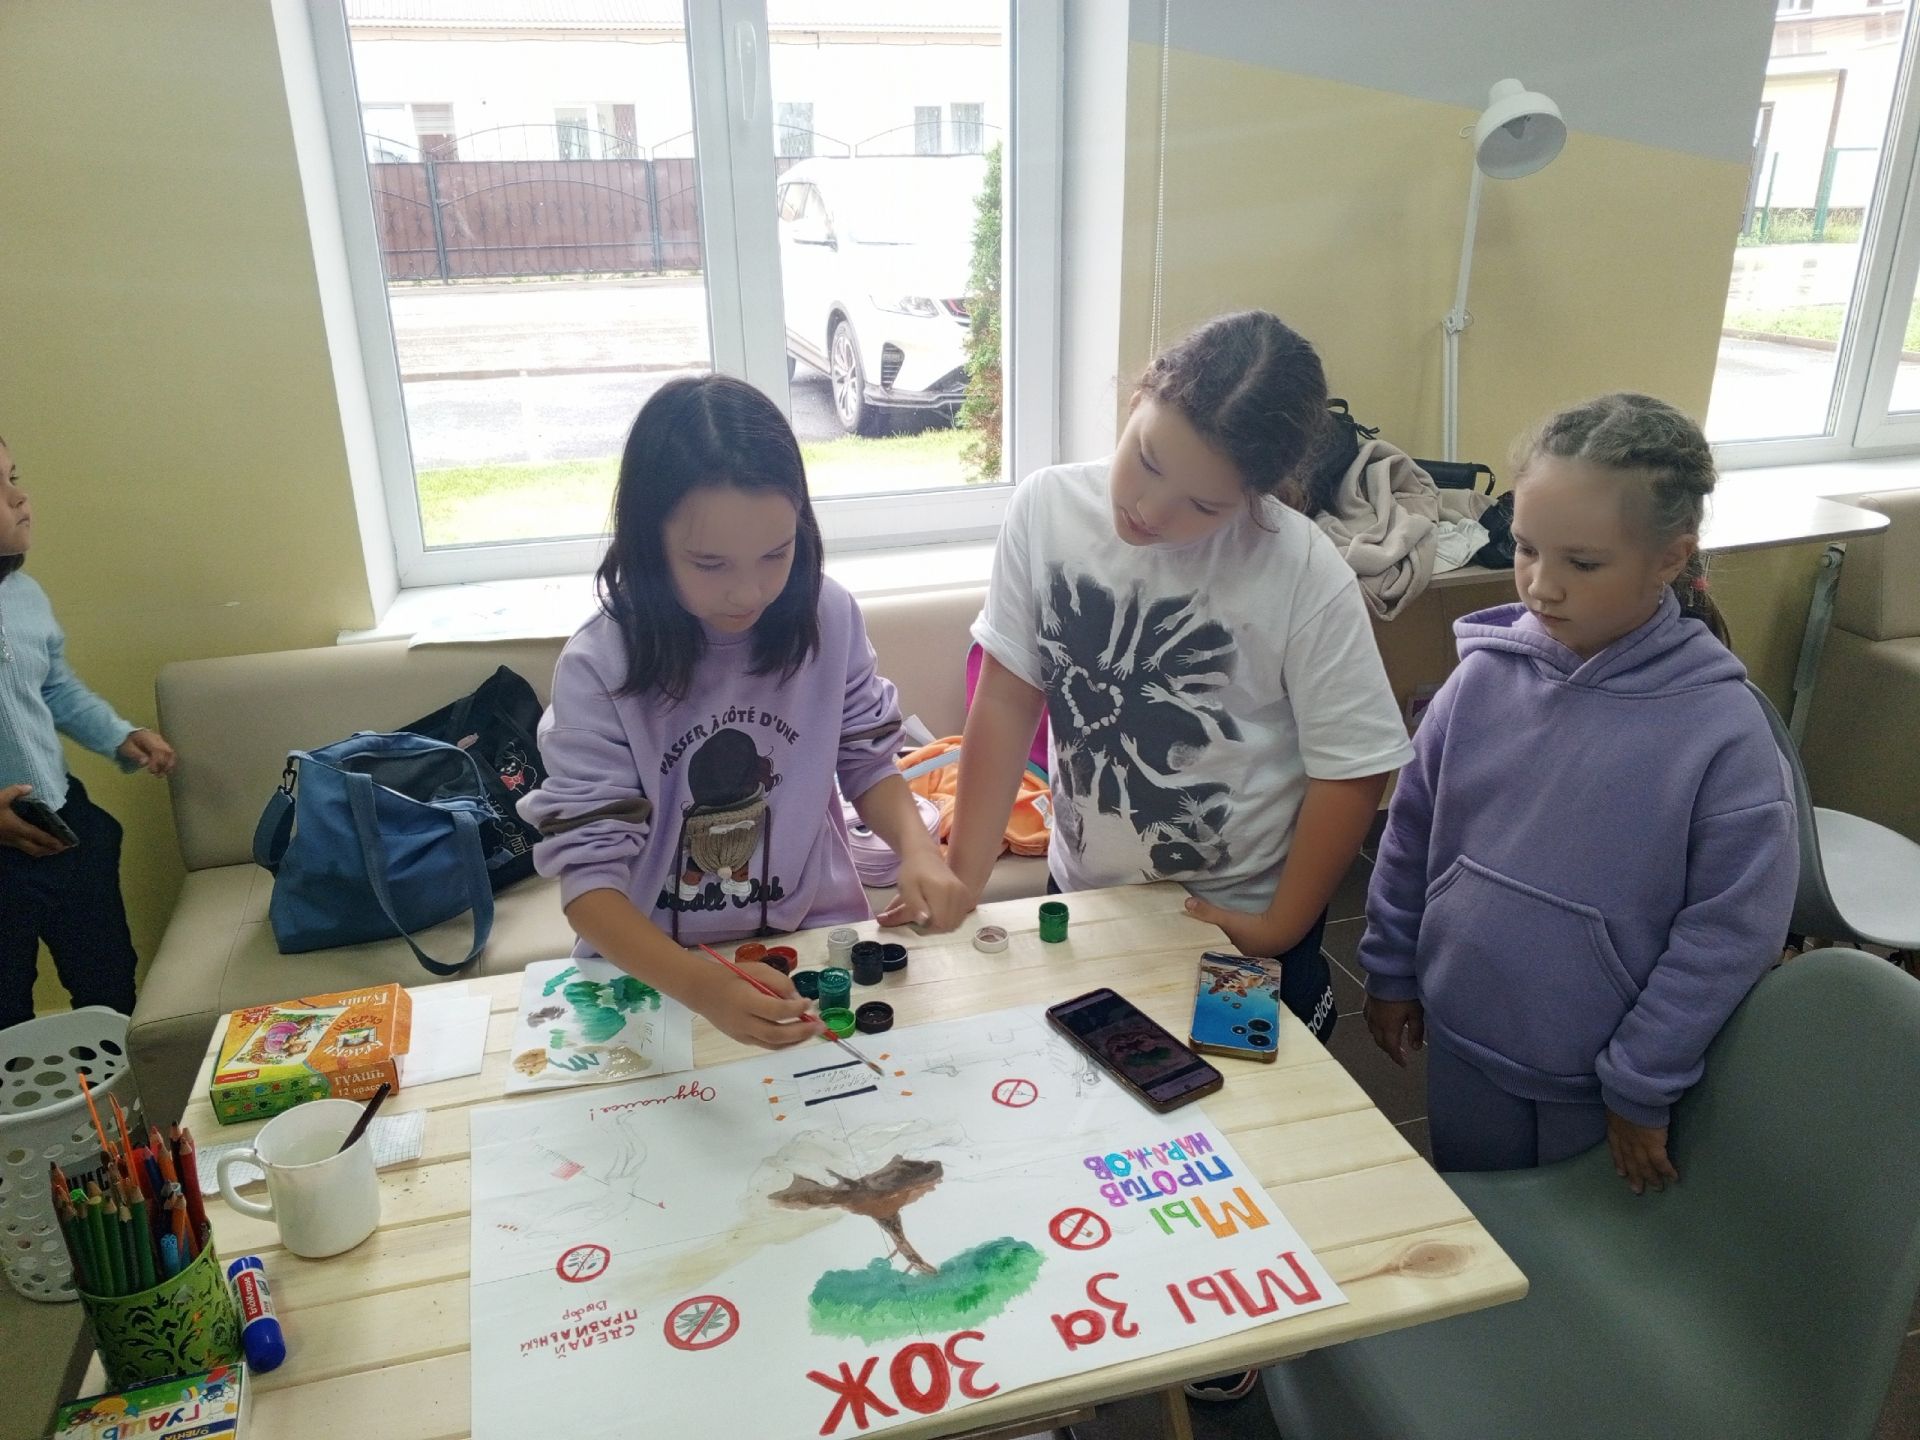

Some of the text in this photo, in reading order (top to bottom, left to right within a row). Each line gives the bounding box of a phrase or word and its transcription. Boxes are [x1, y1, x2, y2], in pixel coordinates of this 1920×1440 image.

[721, 705, 755, 725] CÔTÉ
[759, 712, 800, 745] D'UNE
[334, 1069, 385, 1086] ГУАШЬ
[338, 1083, 381, 1097] 12 красо
[554, 1324, 635, 1359] СДЕЛАЙ
[806, 1331, 1000, 1436] ЗОЖ
[103, 1404, 199, 1440] ГУАШЬ
